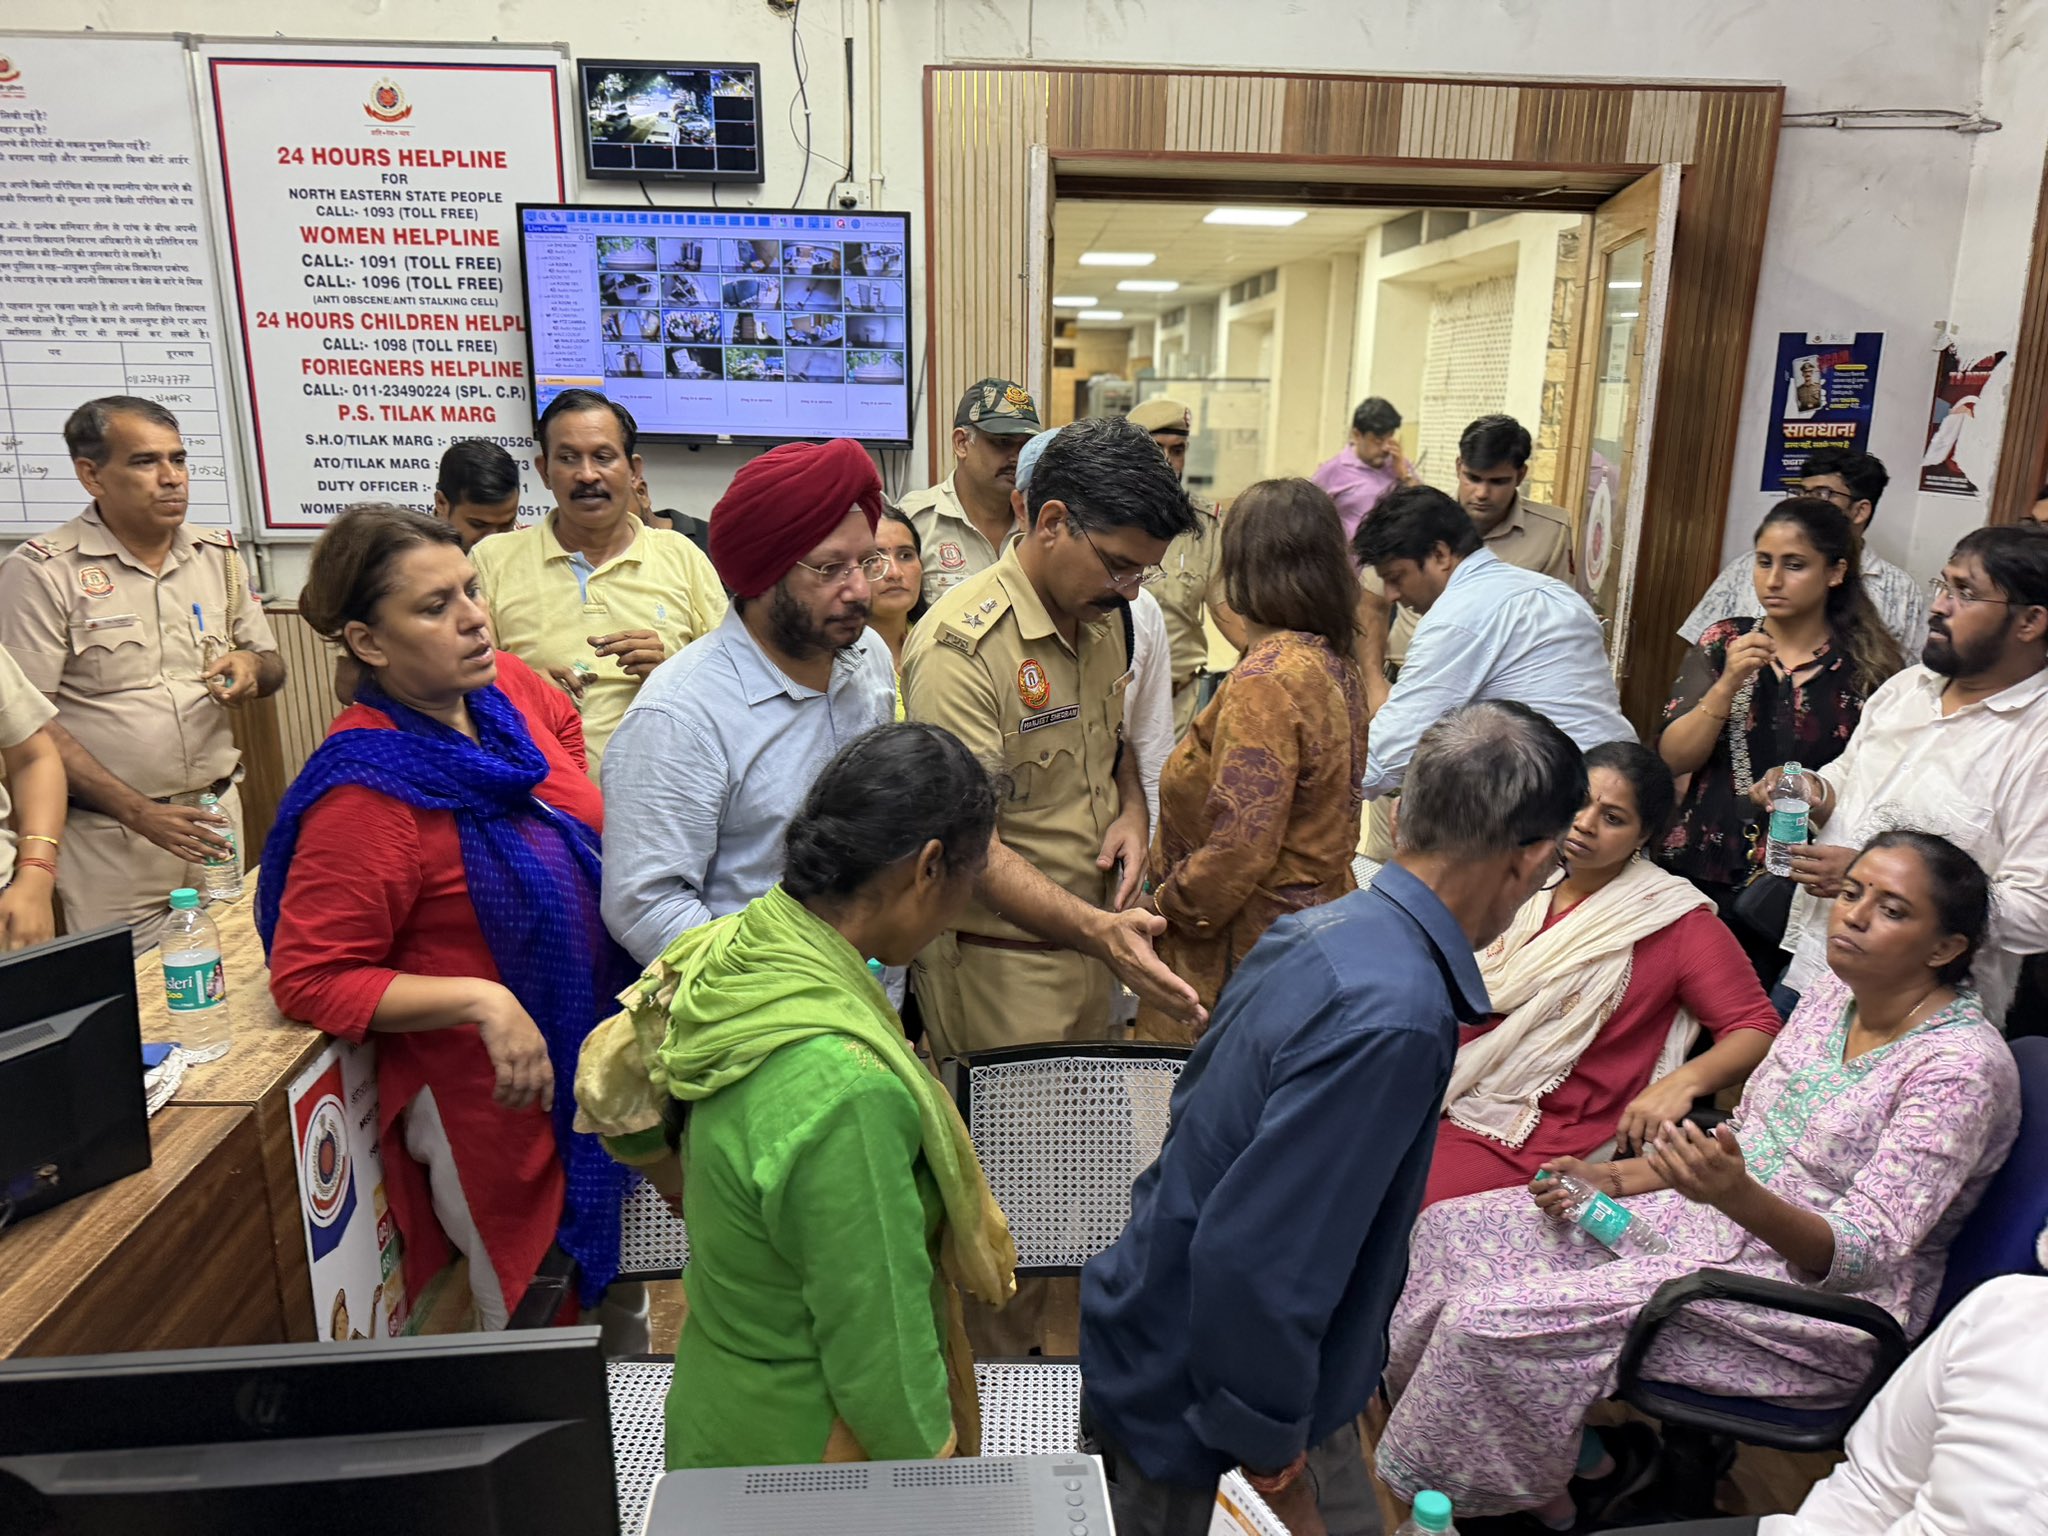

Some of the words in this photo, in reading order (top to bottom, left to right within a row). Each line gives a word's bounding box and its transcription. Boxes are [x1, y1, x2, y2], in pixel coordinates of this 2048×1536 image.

[278, 147, 304, 164] 24
[312, 148, 390, 166] HOURS
[399, 150, 507, 168] HELPLINE
[382, 174, 408, 184] FOR
[289, 189, 335, 199] NORTH
[341, 190, 401, 200] EASTERN
[406, 191, 446, 201] STATE
[451, 192, 502, 202] PEOPLE
[364, 207, 394, 217] 1093
[399, 207, 436, 220] (TOLL
[441, 208, 477, 221] FREE)
[300, 226, 385, 244] WOMEN
[393, 228, 499, 246] HELPLINE
[360, 256, 395, 268] 1091
[405, 256, 450, 271] (TOLL
[456, 257, 501, 273] FREE)
[362, 276, 400, 288] 1096
[407, 277, 452, 291] (TOLL
[458, 277, 503, 293] FREE)
[314, 296, 341, 304] (ANTI
[346, 296, 415, 304] OBSCENE/ANTI
[419, 297, 467, 305] STALKING
[471, 298, 498, 307] CELL)
[257, 312, 279, 328] 24
[286, 312, 354, 329] HOURS
[361, 313, 458, 330] CHILDREN
[466, 315, 525, 331] HELPL
[374, 339, 407, 351] 1098
[413, 339, 452, 353] (TOLL
[457, 340, 497, 354] FREE)
[302, 359, 424, 376] FORIEGNERS
[431, 361, 524, 378] HELPLINE
[353, 384, 450, 397] 011-23490224
[456, 386, 491, 400] (SPL.
[496, 386, 526, 401] C.P.)
[339, 405, 374, 421] P.S.
[380, 405, 435, 421] TILAK
[441, 406, 496, 422] MARG
[1783, 422, 1856, 437] सावधान!
[306, 434, 388, 445] S.H.O/TILAK
[393, 436, 433, 446] MARG
[314, 458, 385, 468] ATO/TILAK
[390, 459, 430, 469] MARG
[318, 481, 354, 491] DUTY
[360, 481, 418, 491] OFFICER
[166, 976, 194, 990] sleri
